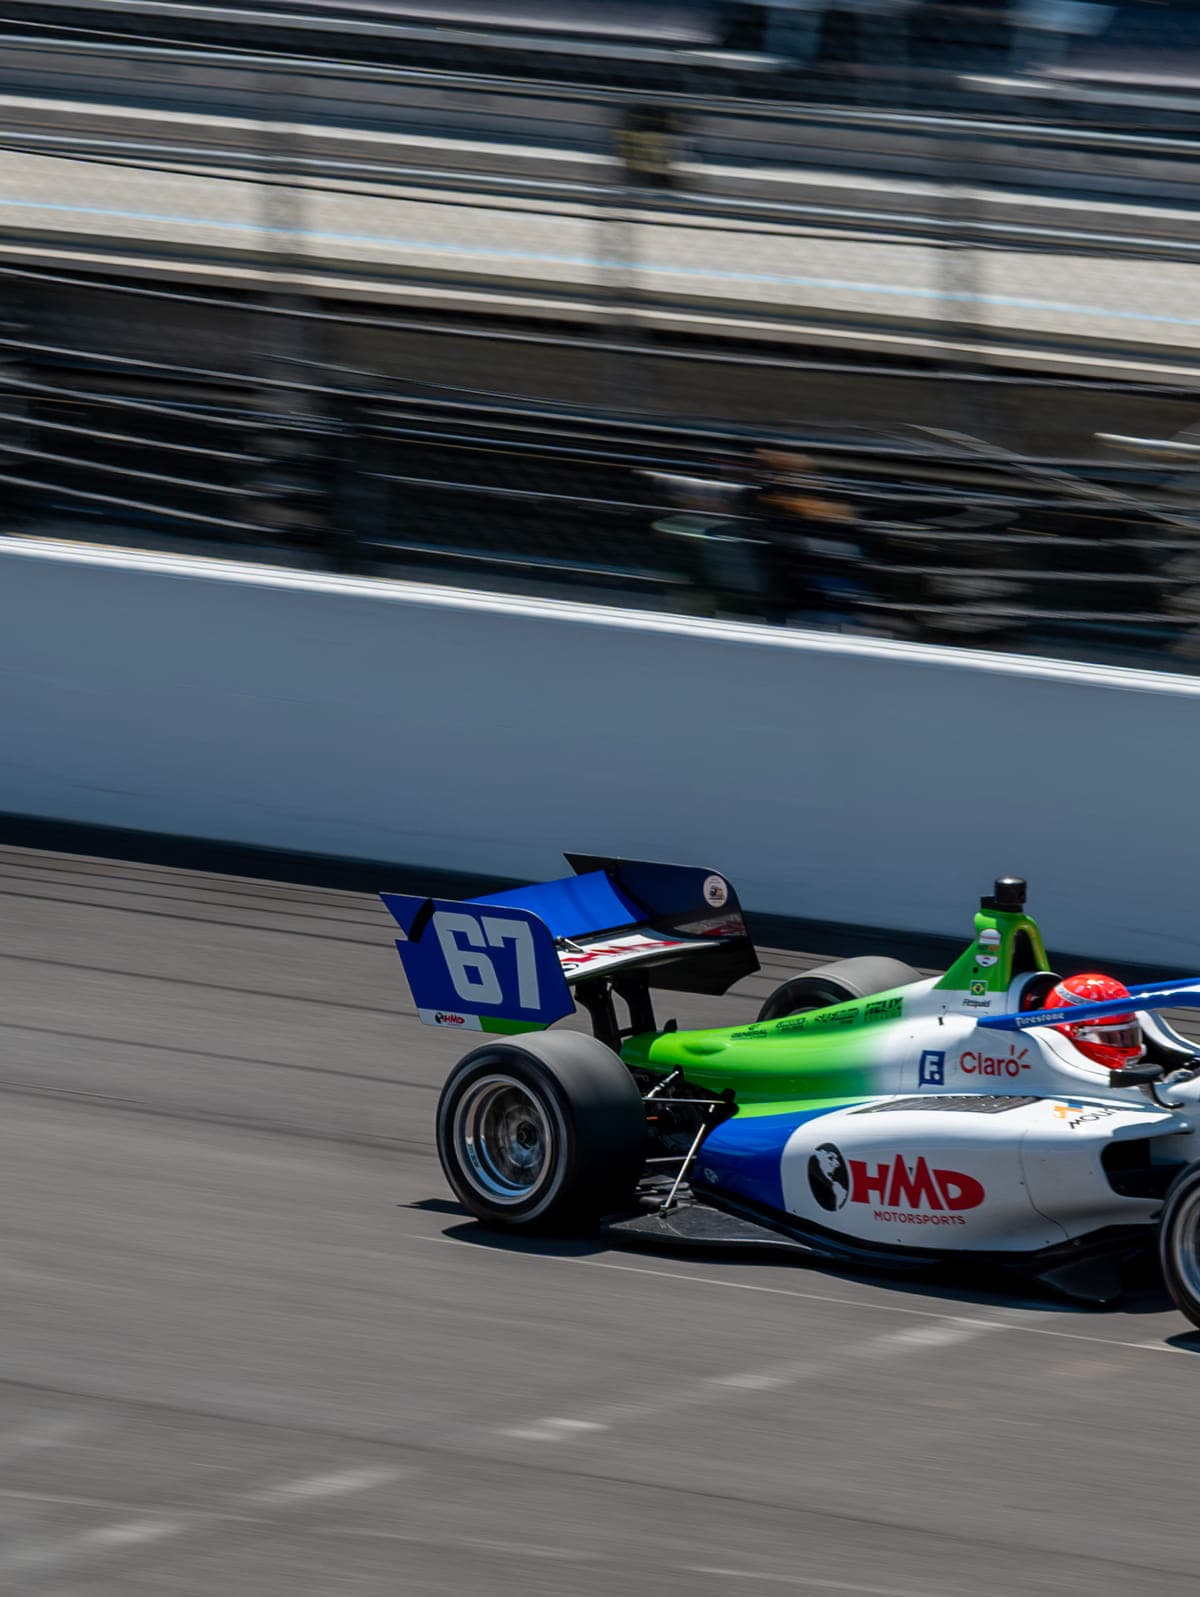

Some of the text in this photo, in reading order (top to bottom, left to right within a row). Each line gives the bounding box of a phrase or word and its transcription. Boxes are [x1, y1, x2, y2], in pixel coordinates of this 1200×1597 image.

[431, 911, 541, 1010] 67
[443, 1013, 465, 1024] HMD
[1016, 1012, 1064, 1027] Firestone
[960, 1051, 1020, 1078] Claro
[848, 1153, 985, 1211] HMD
[873, 1210, 966, 1225] MOTORSPORTS
